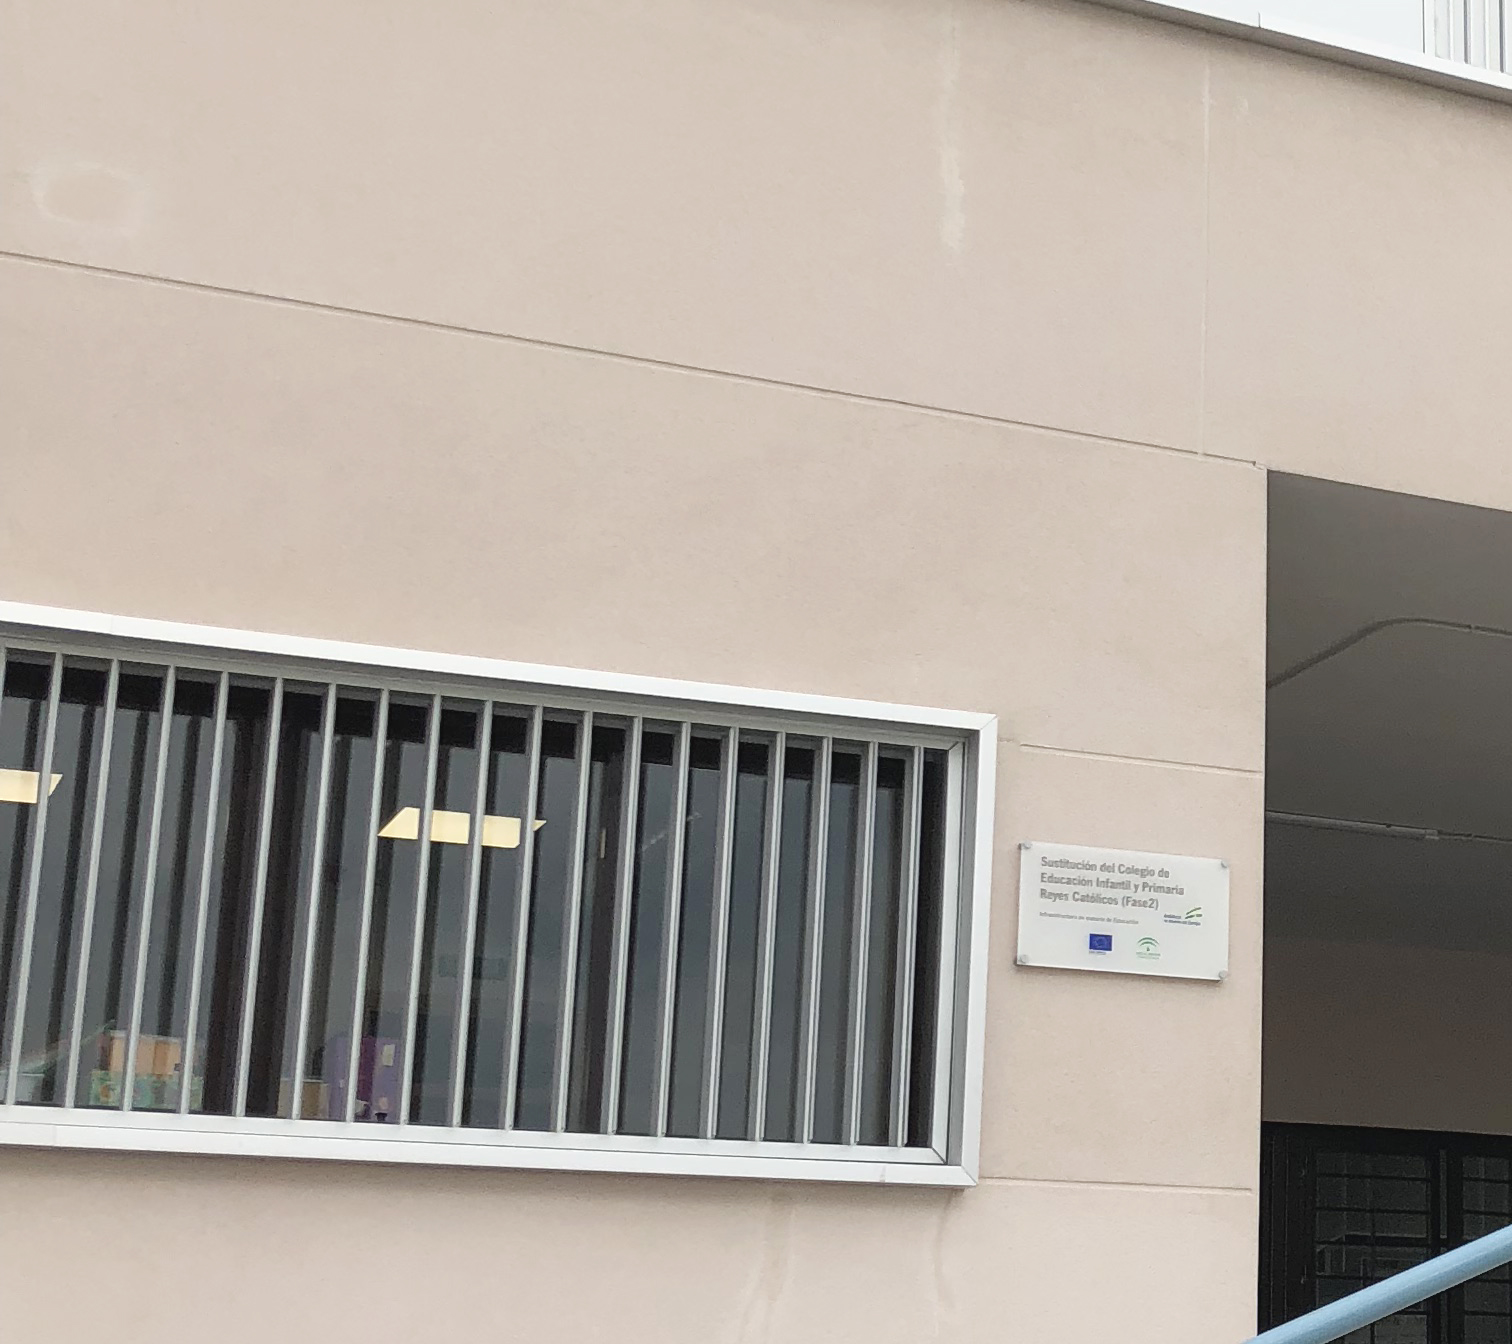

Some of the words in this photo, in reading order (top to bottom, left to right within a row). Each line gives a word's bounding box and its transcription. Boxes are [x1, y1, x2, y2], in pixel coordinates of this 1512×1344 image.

[1041, 856, 1097, 872] Sustitución
[1100, 862, 1115, 873] del
[1118, 863, 1155, 878] Colegio
[1158, 868, 1170, 878] de
[1040, 872, 1093, 887] Educación
[1096, 877, 1131, 890] Infantil
[1134, 883, 1140, 893] y
[1142, 882, 1185, 895] Primaria
[1040, 888, 1069, 902] Reyes
[1072, 891, 1118, 906] Católicos
